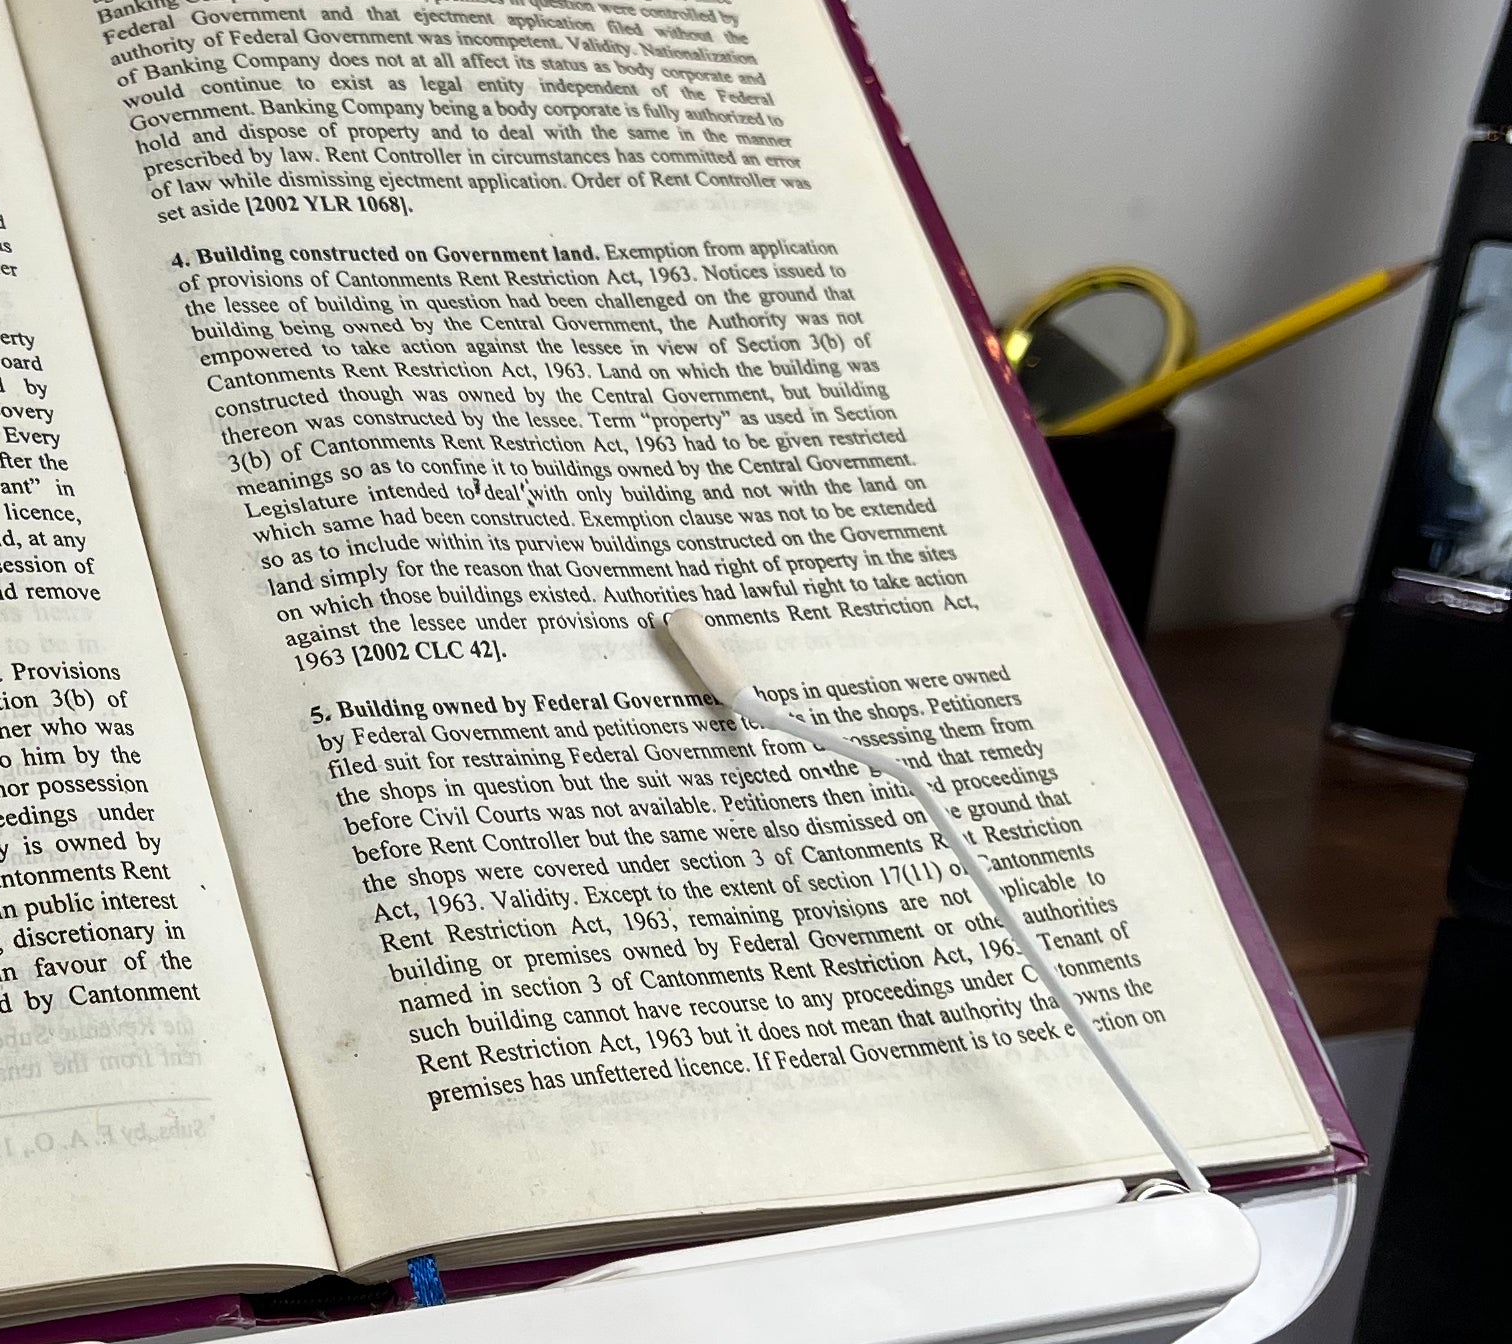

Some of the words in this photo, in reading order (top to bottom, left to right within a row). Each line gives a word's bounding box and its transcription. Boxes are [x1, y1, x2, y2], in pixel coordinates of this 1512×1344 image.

[158, 206, 186, 223] set
[191, 198, 240, 217] aside
[245, 196, 299, 216] [2002
[303, 195, 352, 212] YLR
[357, 196, 413, 216] 1068].
[172, 253, 190, 268] 4.
[196, 245, 285, 266] Building
[290, 246, 399, 262] constructed
[405, 250, 428, 262] on
[434, 246, 549, 262] Government
[552, 245, 600, 261] land.
[604, 243, 699, 263] Exemption
[704, 240, 744, 256] from
[750, 240, 838, 259] application
[179, 274, 200, 292] of
[207, 270, 303, 293] provisions
[311, 270, 329, 287] of
[336, 271, 452, 287] Cantonments
[456, 271, 500, 287] Rent
[504, 270, 599, 286] Restriction
[608, 269, 643, 287] Act,
[649, 266, 697, 283] 1963.
[702, 264, 768, 281] Notices
[774, 263, 825, 278] issued
[830, 266, 846, 277] to
[11, 661, 120, 680] Provisions
[295, 648, 345, 672] 1963
[352, 642, 409, 667] [2002
[415, 641, 464, 660] CLC
[470, 640, 506, 662] 42].
[311, 706, 331, 724] 5.
[336, 699, 428, 720] Building
[433, 696, 498, 715] owned
[502, 696, 526, 717] by
[532, 693, 609, 712] Federal
[613, 691, 723, 709] Governme
[753, 685, 799, 706] hops
[801, 682, 822, 699] in
[826, 676, 902, 701] question
[904, 675, 949, 689] were
[953, 665, 1011, 685] owned
[23, 836, 43, 855] is
[56, 831, 127, 852] owned
[136, 831, 160, 855] by
[427, 1076, 524, 1111] premises
[527, 1071, 565, 1090] has
[570, 1059, 673, 1086] unfettered
[674, 1057, 750, 1077] licence.
[752, 1051, 772, 1071] If
[774, 1045, 846, 1069] Federal
[850, 1035, 968, 1063] Government
[969, 1031, 988, 1049] is
[992, 1031, 1012, 1046] to
[1017, 1021, 1061, 1043] seek
[1064, 1012, 1138, 1037] ection
[1143, 1010, 1166, 1024] on
